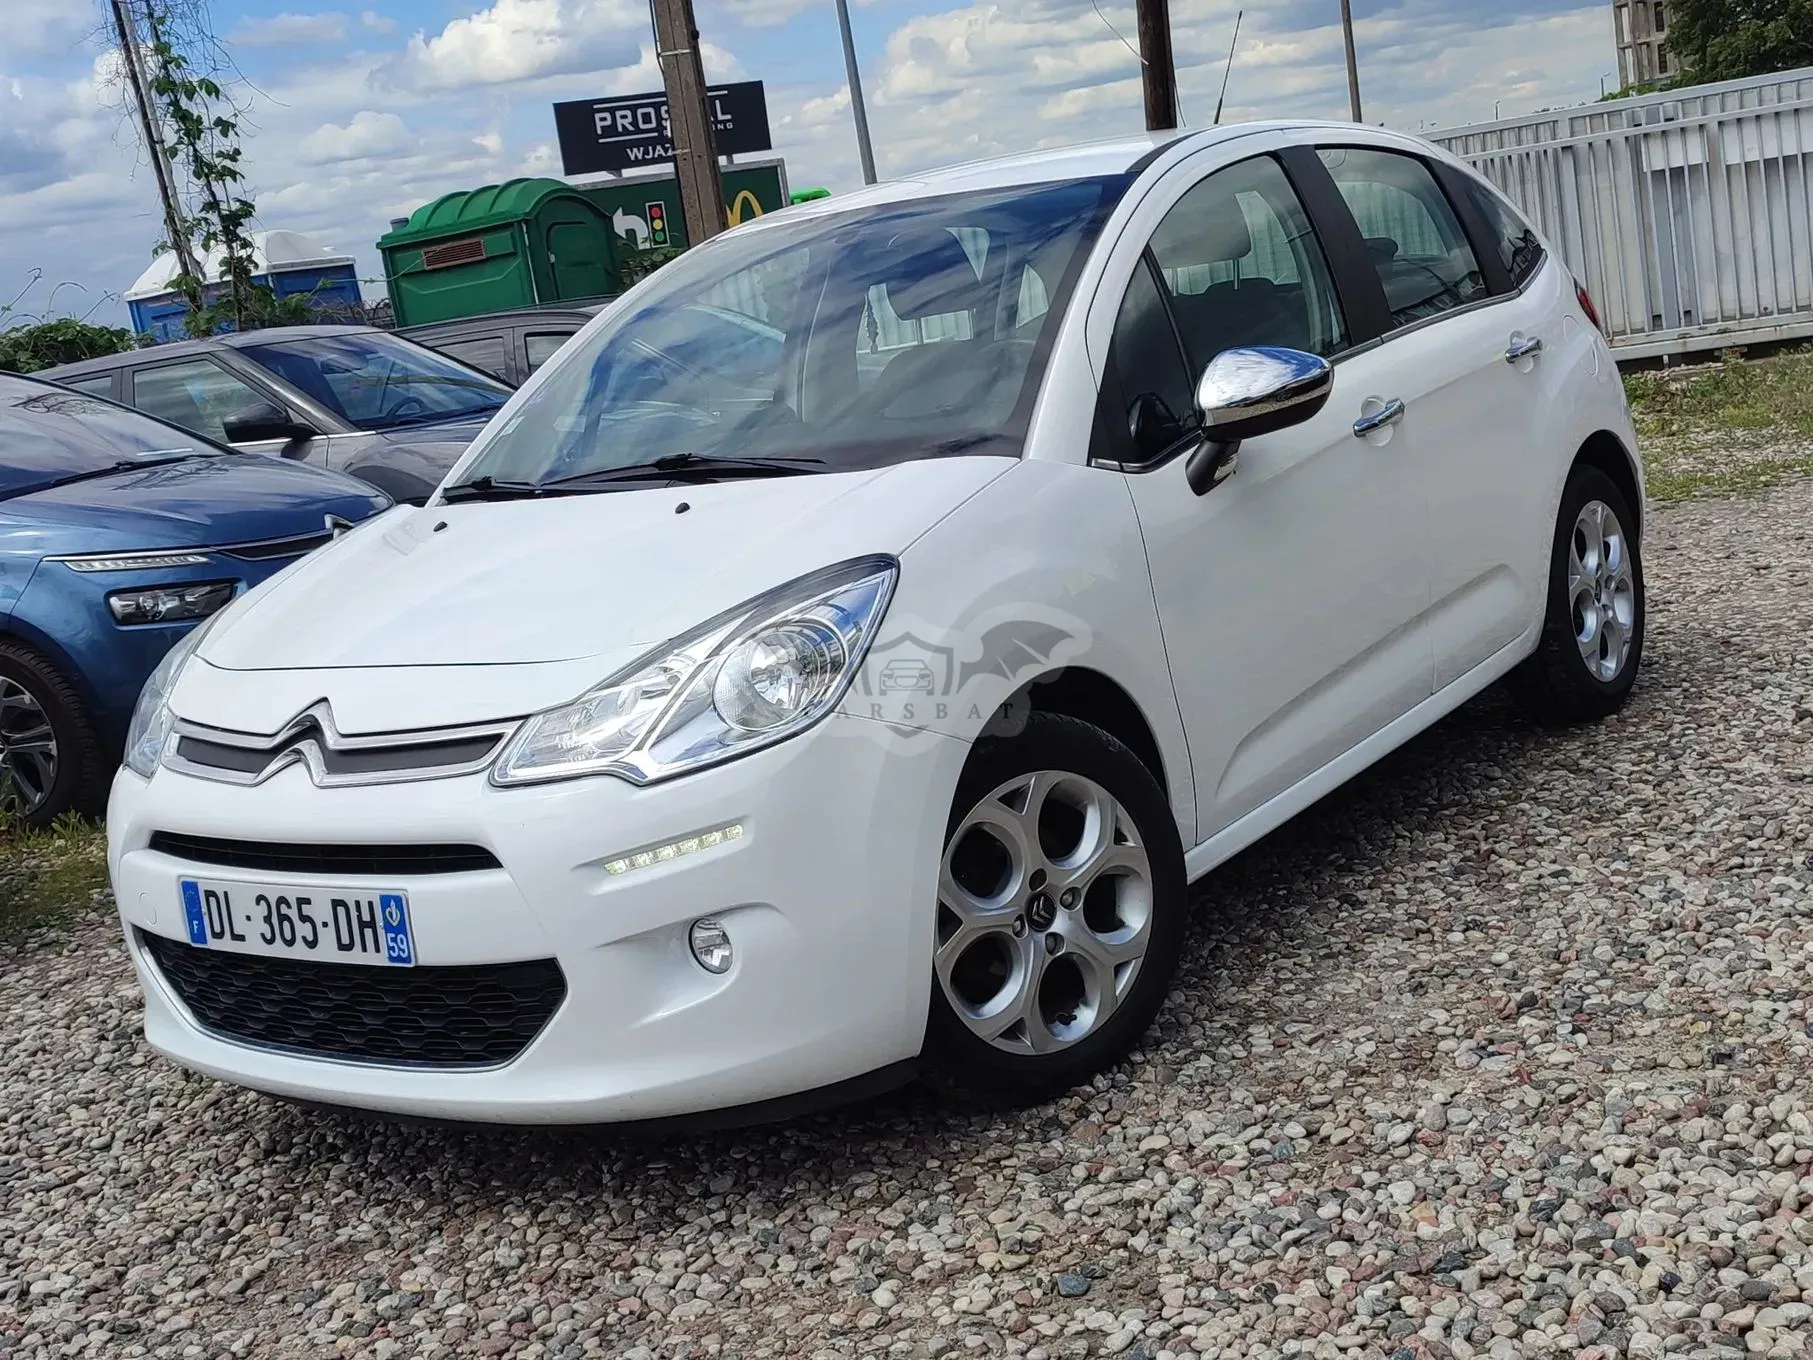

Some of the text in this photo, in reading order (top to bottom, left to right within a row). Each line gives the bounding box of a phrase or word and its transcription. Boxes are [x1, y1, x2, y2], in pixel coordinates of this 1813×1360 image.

[626, 143, 673, 161] WJAZ
[192, 920, 199, 934] F
[387, 933, 409, 958] 59
